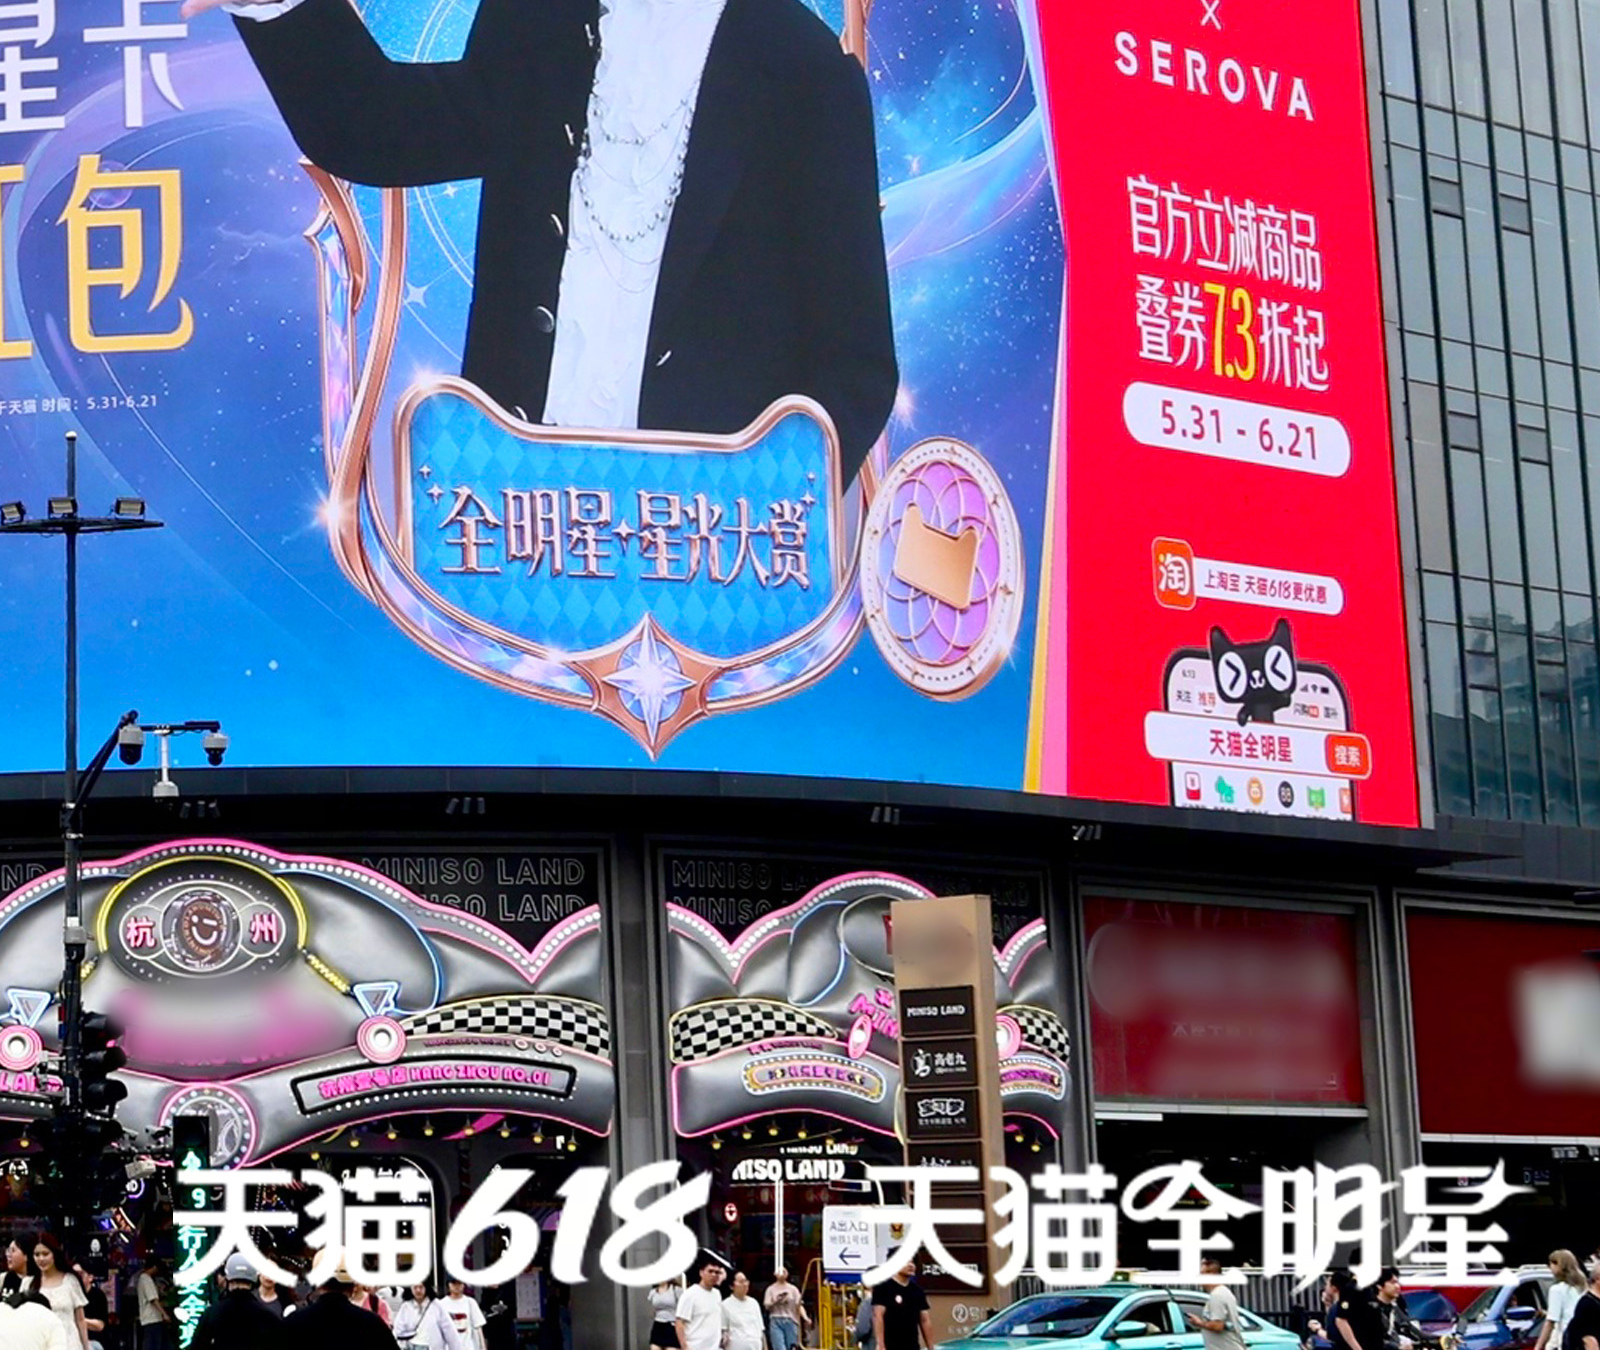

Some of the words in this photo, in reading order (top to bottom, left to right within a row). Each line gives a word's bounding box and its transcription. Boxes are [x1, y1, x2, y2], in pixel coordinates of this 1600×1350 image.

[1114, 31, 1315, 122] SEROVA
[1127, 174, 1324, 293] 官方立减商品
[1135, 274, 1330, 392] 叠券7.3折起
[1158, 552, 1191, 596] 淘
[1209, 729, 1293, 763] 天猫全明星
[498, 858, 585, 885] LAND
[906, 1007, 938, 1017] MINISO
[941, 1005, 965, 1015] LAND
[785, 1159, 845, 1180] LAND
